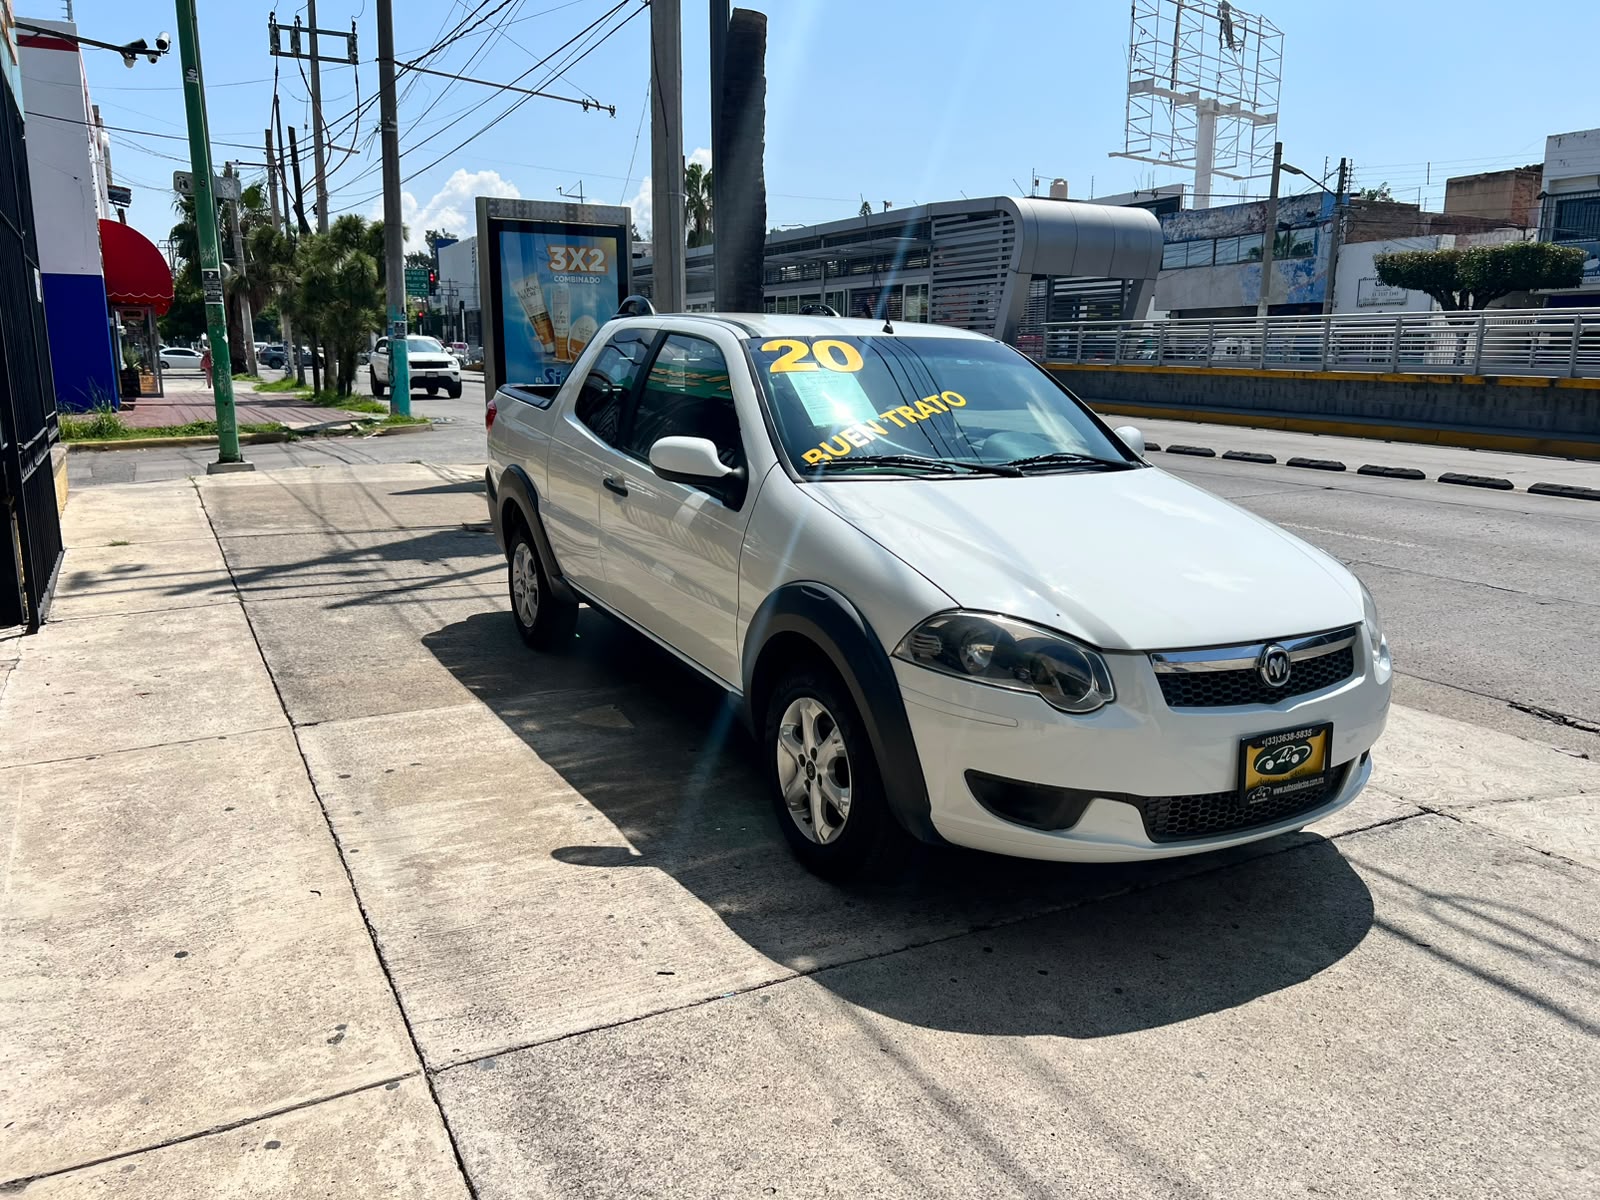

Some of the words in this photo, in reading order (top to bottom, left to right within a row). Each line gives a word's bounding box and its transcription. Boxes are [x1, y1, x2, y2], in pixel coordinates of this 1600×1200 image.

[549, 245, 607, 273] 3X2
[553, 275, 601, 284] COMBINADO
[761, 339, 864, 372] 20
[801, 418, 889, 465] BUEN
[879, 390, 967, 428] TRATO
